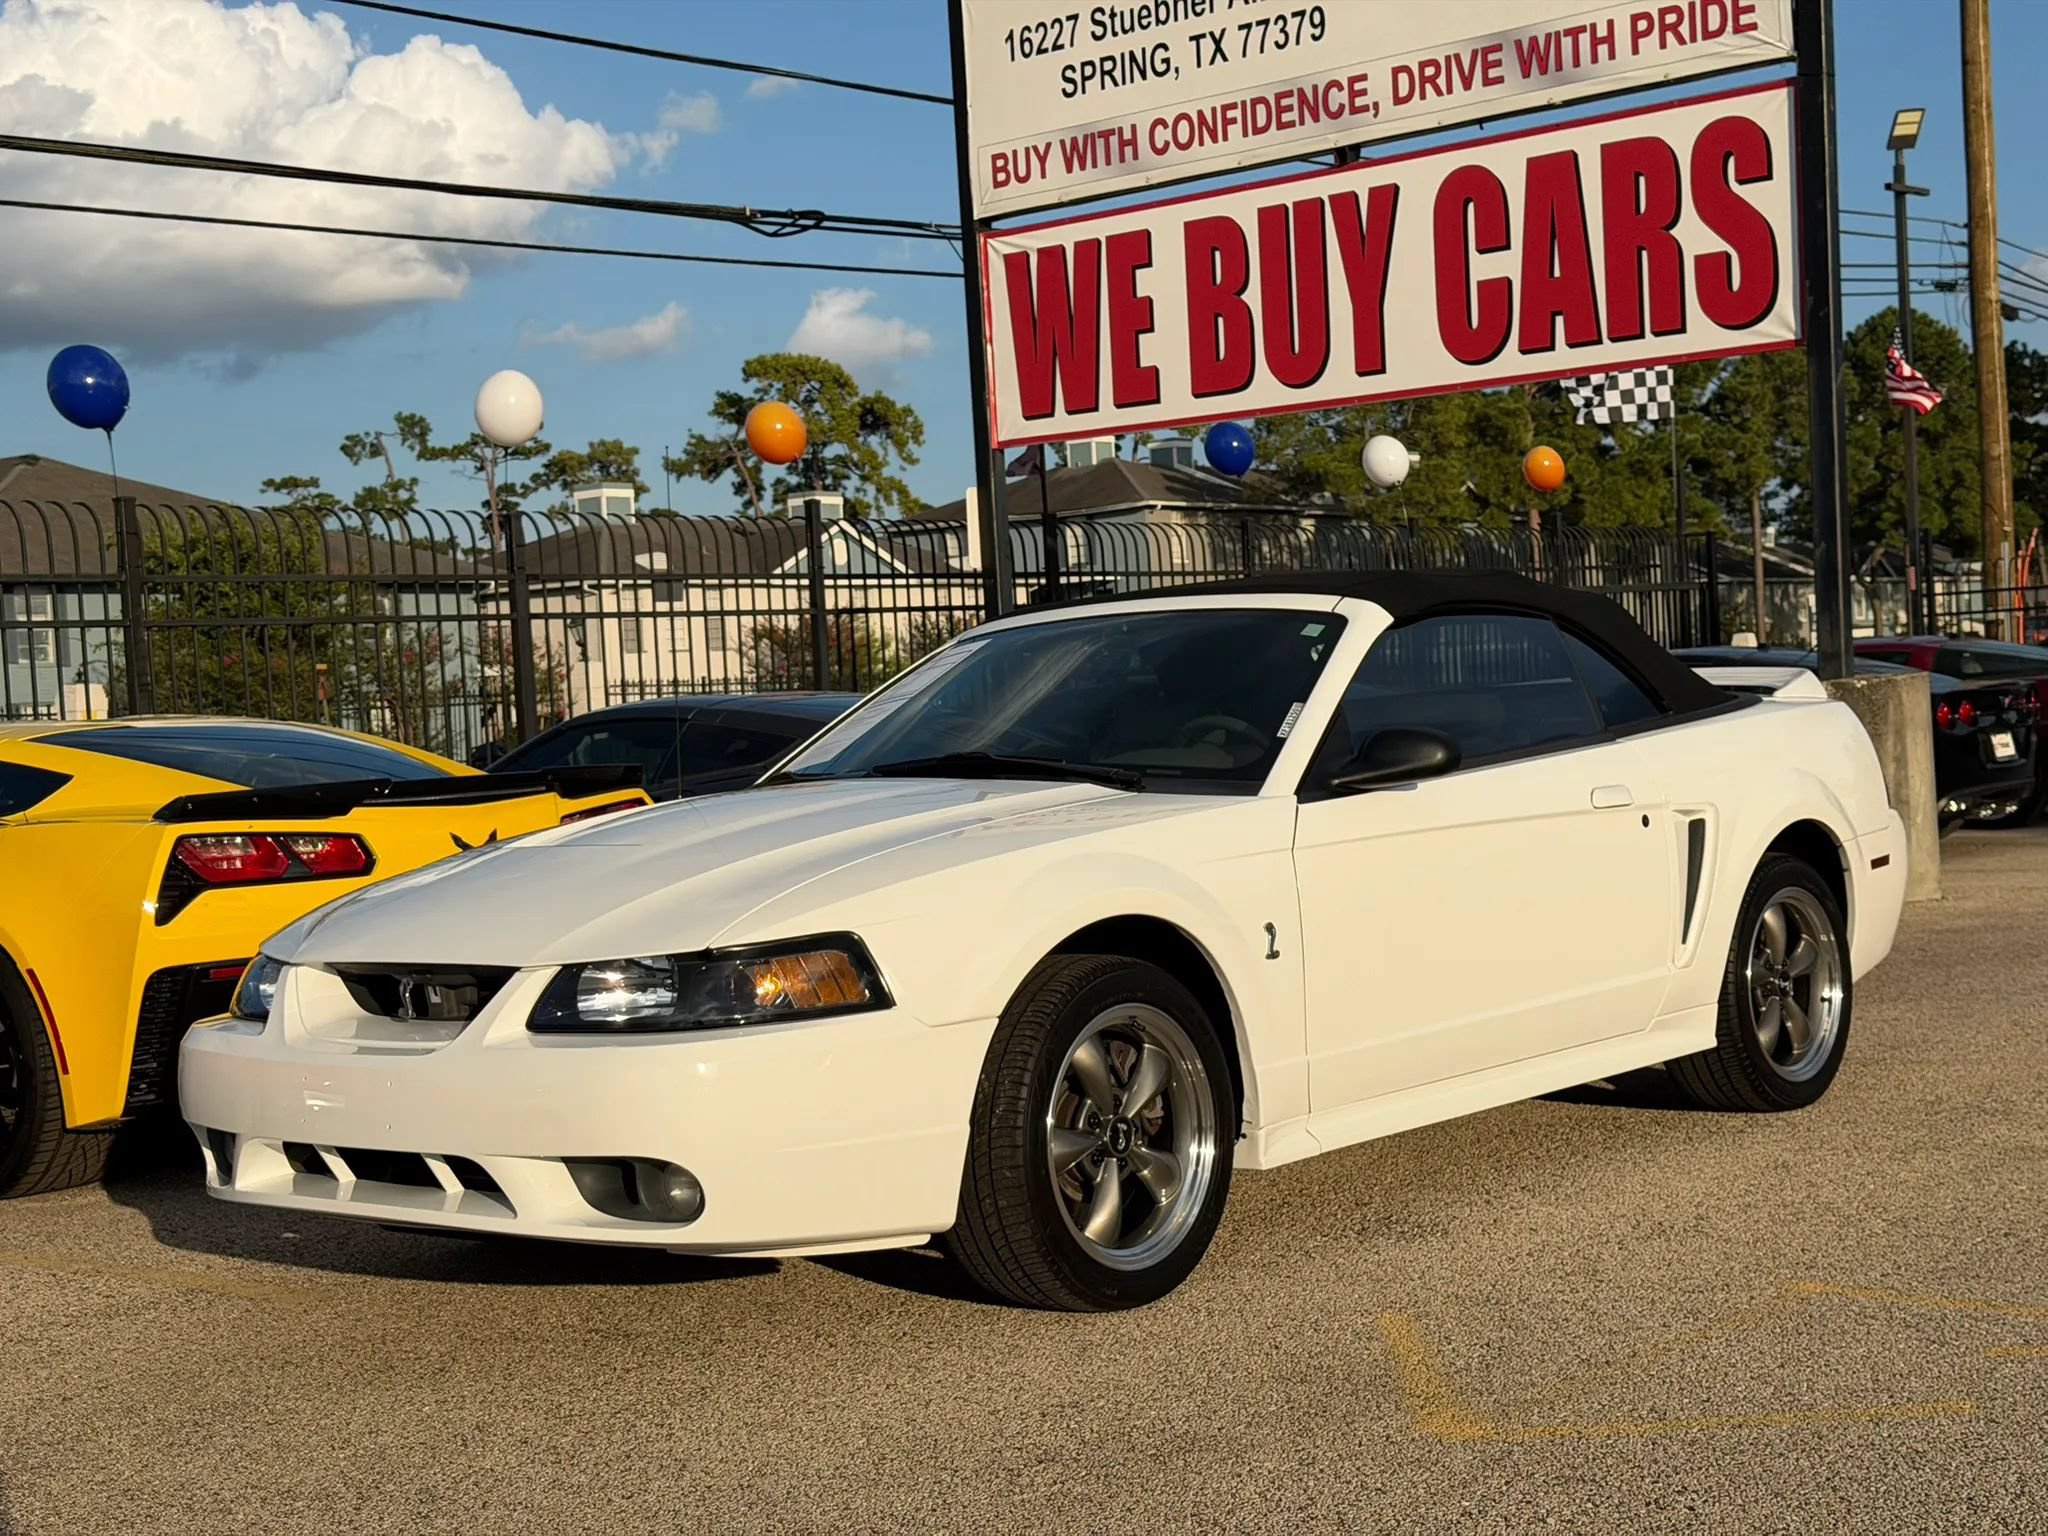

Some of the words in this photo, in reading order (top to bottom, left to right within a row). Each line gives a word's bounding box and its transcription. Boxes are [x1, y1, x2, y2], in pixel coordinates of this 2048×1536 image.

[991, 141, 1052, 190] BUY
[1059, 123, 1140, 174] WITH
[1148, 73, 1381, 156] CONFIDENCE,
[1391, 42, 1505, 107] DRIVE
[1513, 18, 1617, 80] WITH
[1630, 0, 1760, 56] PRIDE
[1004, 12, 1081, 62] 16227
[1061, 42, 1181, 99] SPRING,
[1188, 27, 1230, 69] TX
[1237, 5, 1327, 59] 77379
[1003, 228, 1162, 421] WE
[1183, 183, 1401, 400] BUY
[1433, 116, 1780, 366] CARS
